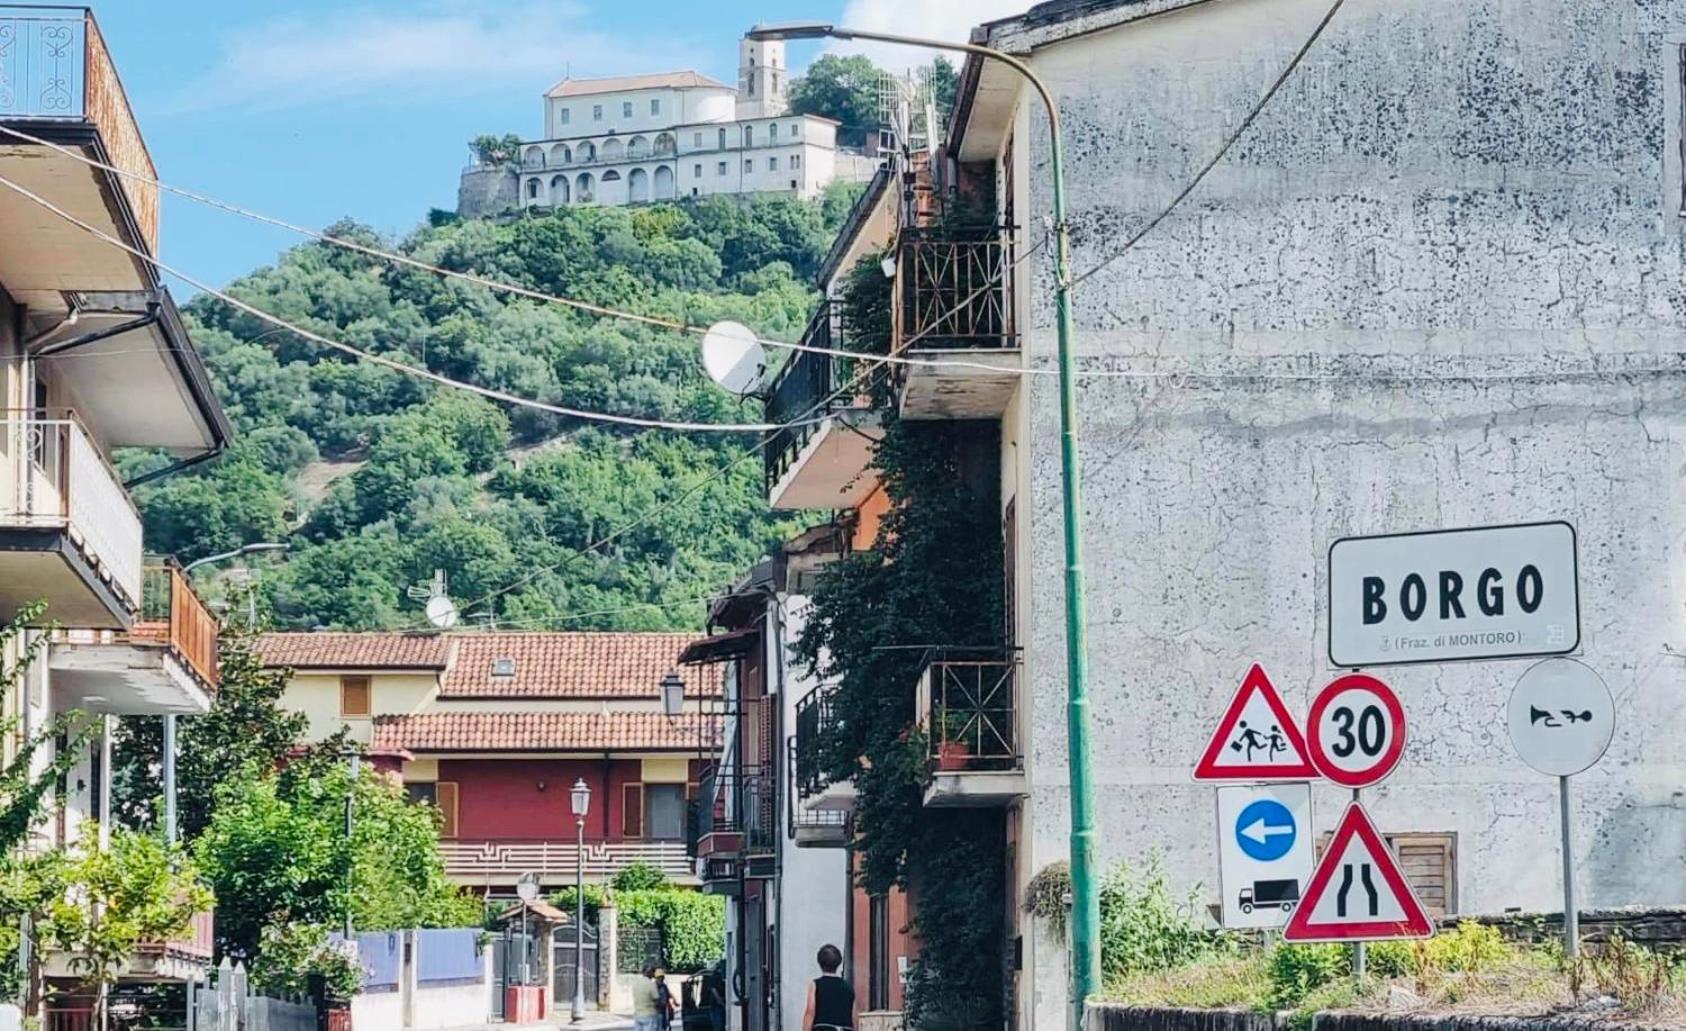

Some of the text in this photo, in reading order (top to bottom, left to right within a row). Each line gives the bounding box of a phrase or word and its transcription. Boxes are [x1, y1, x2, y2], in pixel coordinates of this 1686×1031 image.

[1362, 564, 1543, 625] BORGO
[1394, 631, 1522, 650] (Fraz. di MONTORO)
[1331, 705, 1386, 757] 30
